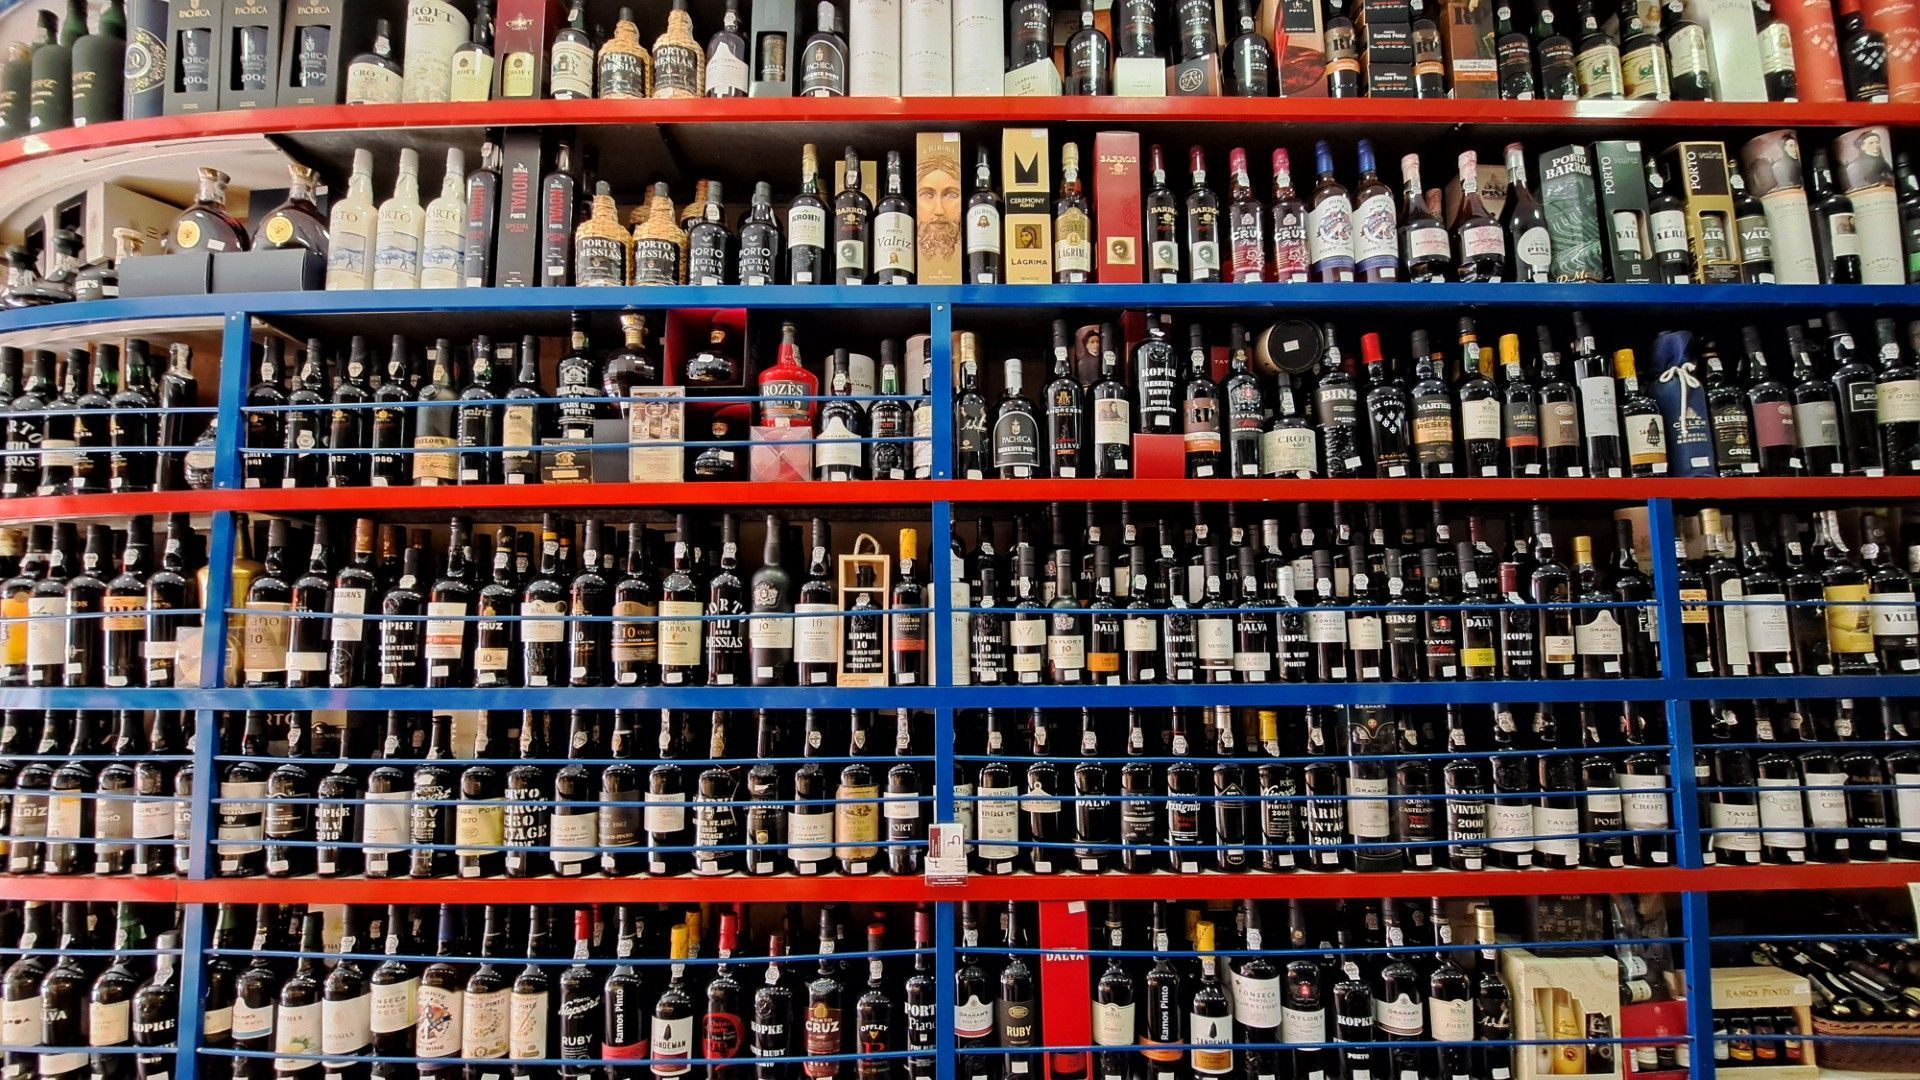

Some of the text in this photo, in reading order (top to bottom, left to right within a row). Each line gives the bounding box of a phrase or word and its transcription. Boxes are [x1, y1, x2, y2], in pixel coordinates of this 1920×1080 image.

[602, 52, 637, 64] PORTO
[656, 46, 689, 58] PORTO
[1551, 154, 1587, 168] PORTO
[1545, 163, 1592, 180] BARROS
[1602, 155, 1614, 195] PORTO
[1689, 151, 1700, 190] PORTO
[510, 173, 528, 211] NOVAL
[548, 187, 563, 225] NOVAL
[836, 206, 868, 216] BARROS
[582, 239, 617, 249] PORTO
[637, 241, 671, 251] PORTO
[877, 233, 911, 249] Valriz
[580, 248, 621, 259] MESSIAS
[636, 250, 675, 261] MESSIAS
[1011, 256, 1048, 266] LÁGRIMA
[1141, 368, 1176, 378] KOPKE
[762, 381, 803, 396] ROZÈS
[1148, 388, 1172, 396] TAWNY
[1278, 435, 1312, 445] CROFT
[478, 622, 503, 630] CRUZ
[622, 627, 635, 638] 10
[848, 632, 877, 641] KOPKE
[972, 635, 1001, 644] KOPKE
[614, 989, 624, 1044] Ramos Pinto
[1160, 985, 1169, 1041] Ramos Pinto
[805, 1020, 839, 1034] CRUZ
[860, 1023, 888, 1032] OFFLEY
[1006, 1025, 1031, 1037] RUBY
[562, 1034, 593, 1046] RUBY
